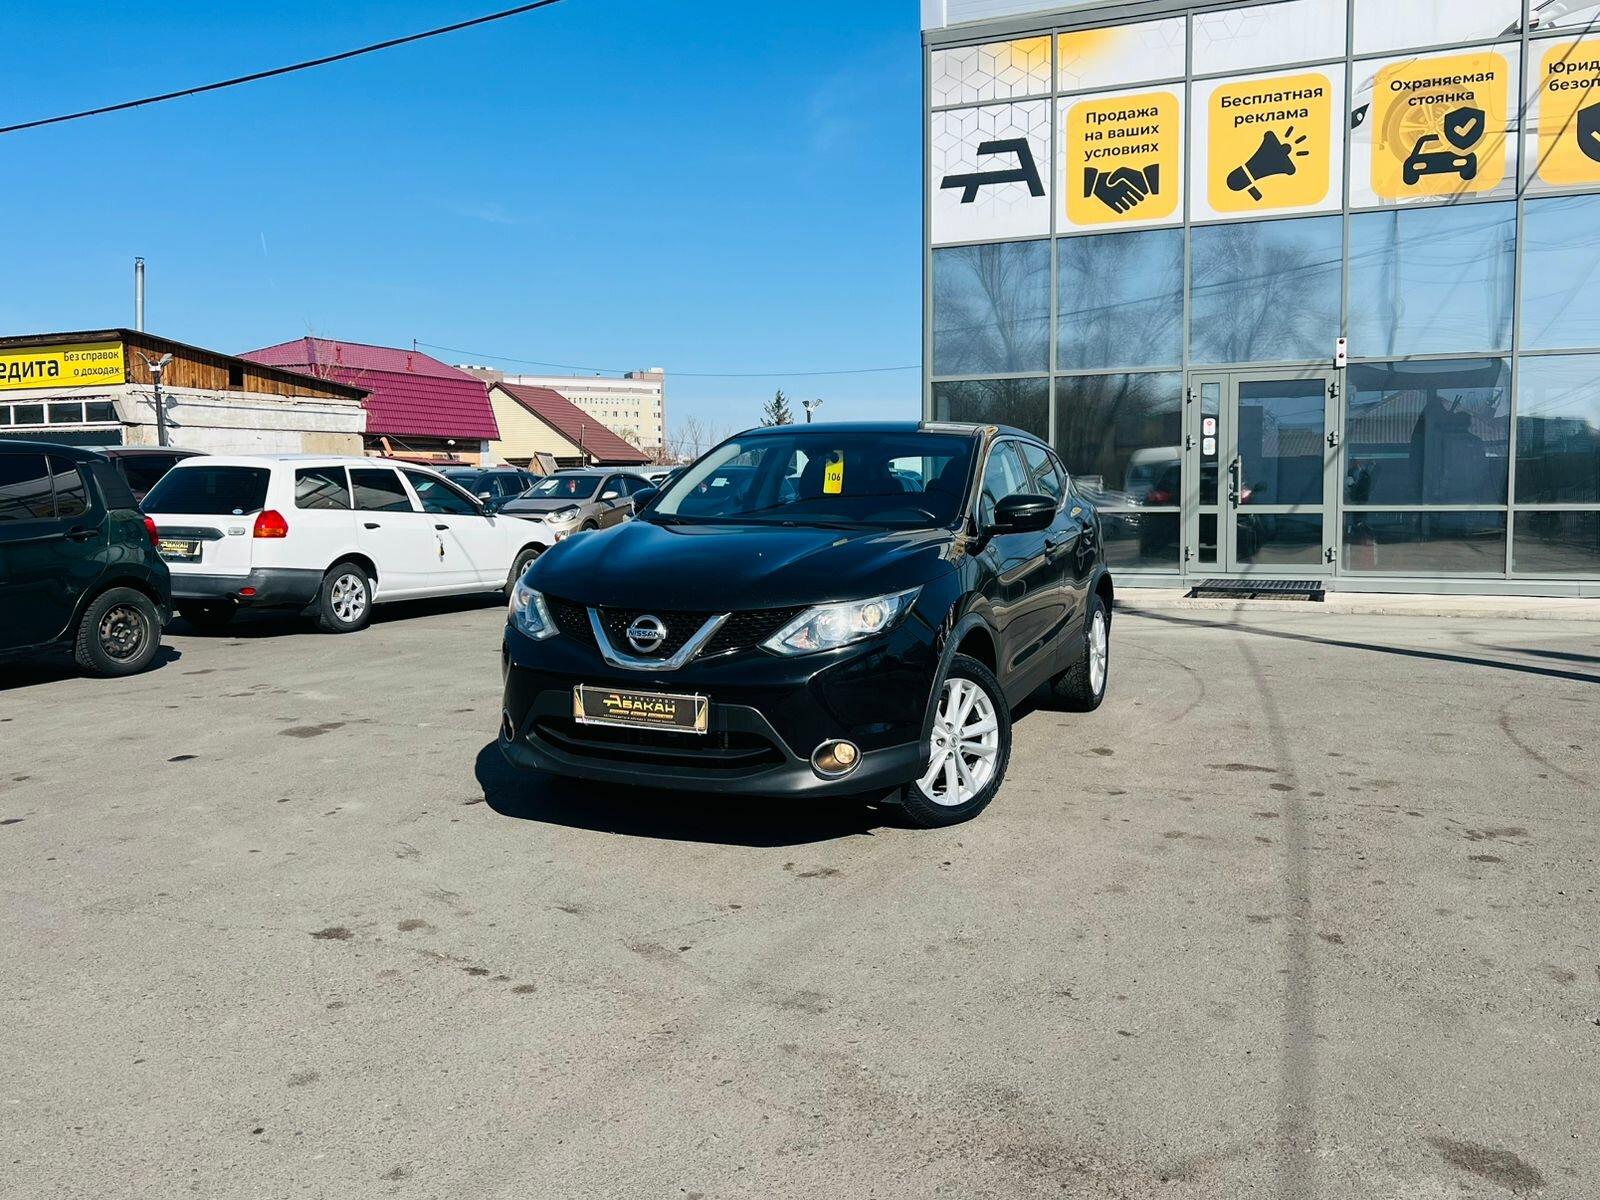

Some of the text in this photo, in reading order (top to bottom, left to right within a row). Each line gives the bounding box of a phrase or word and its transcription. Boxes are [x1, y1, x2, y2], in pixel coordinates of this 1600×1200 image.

[1390, 71, 1495, 92] Охраняемая
[1221, 87, 1324, 108] Бесплатная
[1408, 91, 1475, 107] стоянка
[1085, 106, 1159, 125] Продажа
[1234, 108, 1309, 128] реклама
[1084, 124, 1160, 142] на ваших
[1083, 142, 1160, 162] условиях
[63, 350, 119, 363] Без справок
[73, 365, 120, 377] о доходах
[827, 472, 841, 482] 106
[628, 629, 661, 638] NISSAN
